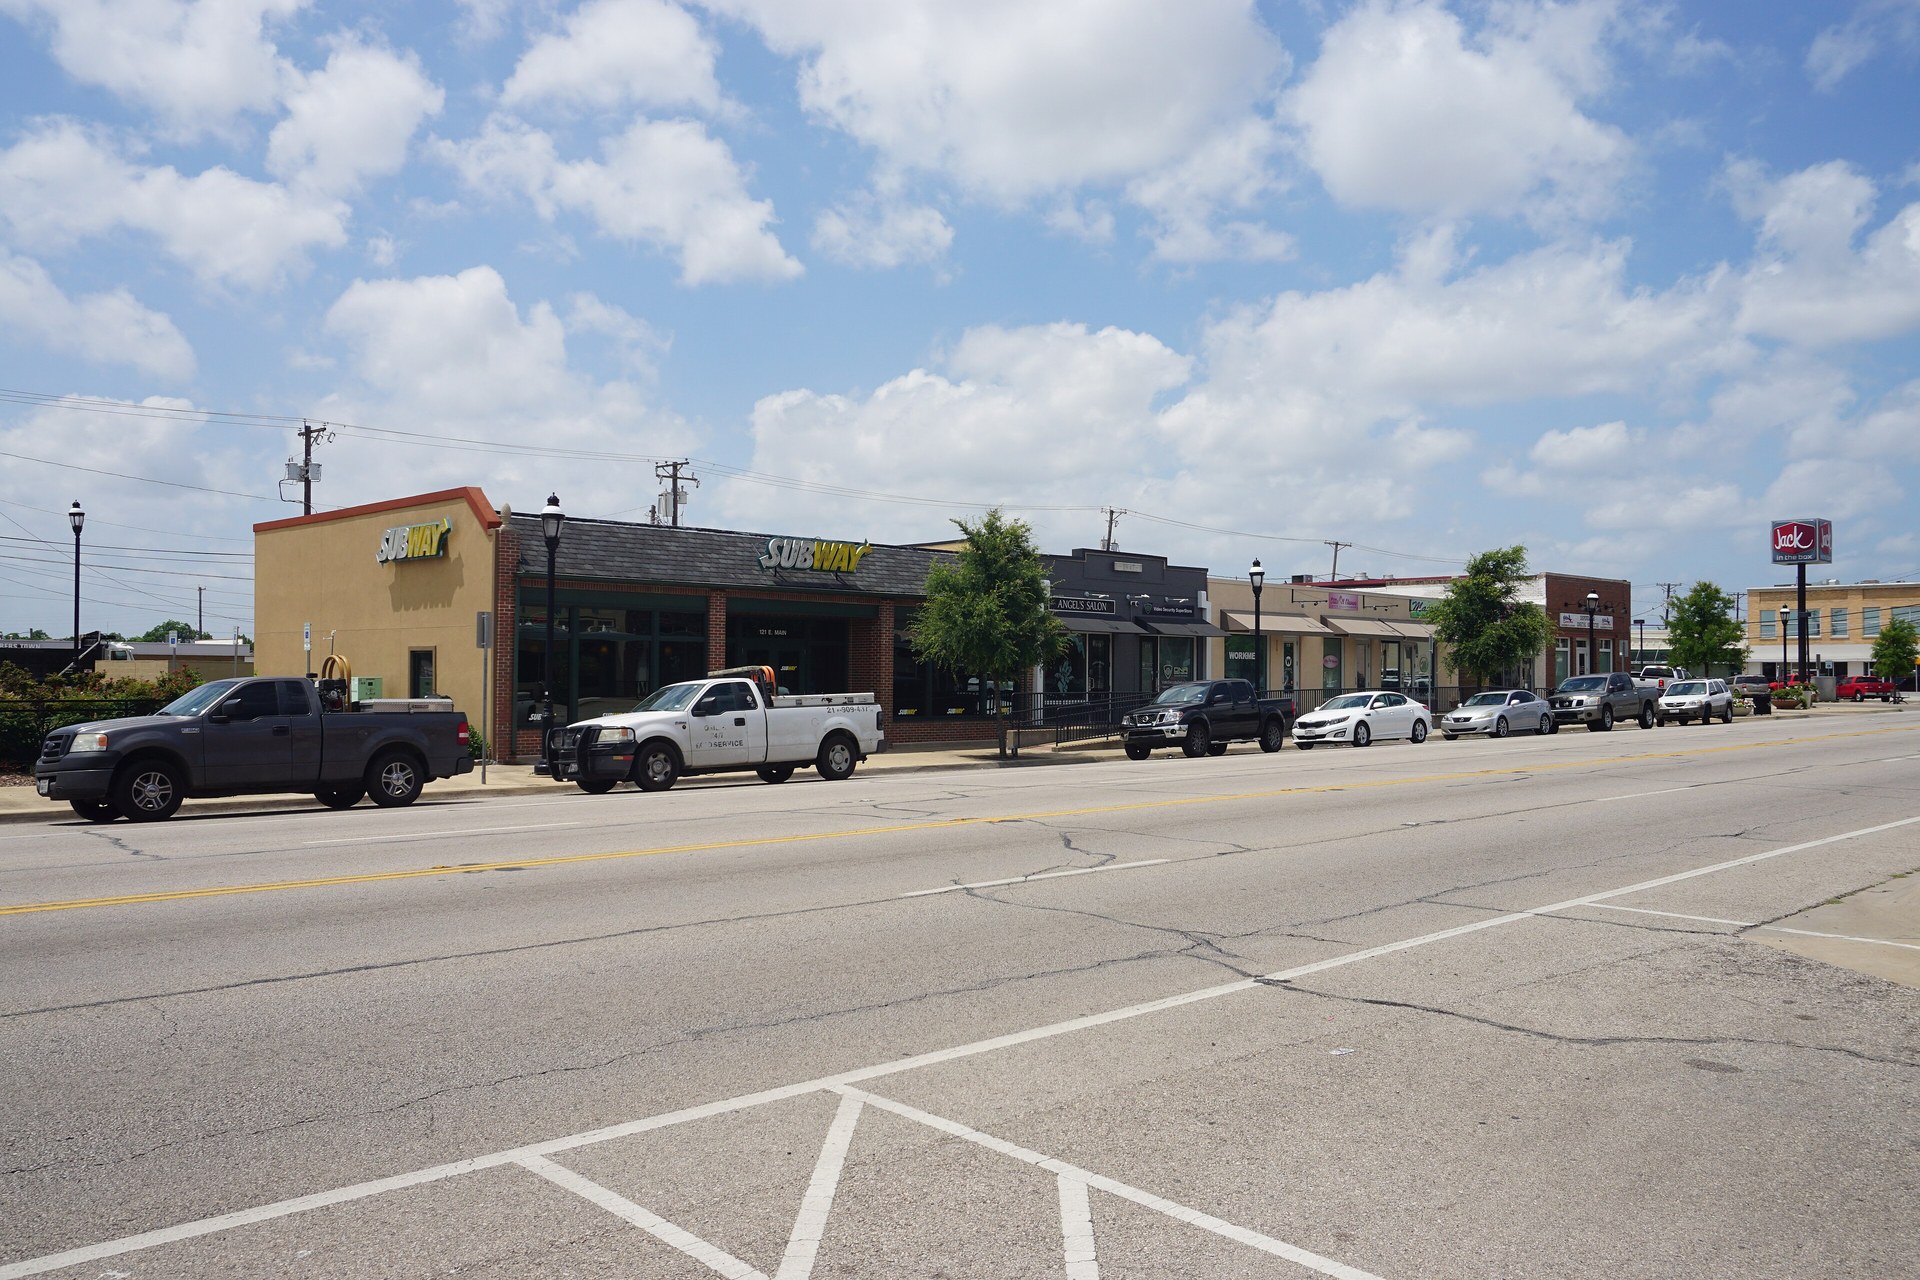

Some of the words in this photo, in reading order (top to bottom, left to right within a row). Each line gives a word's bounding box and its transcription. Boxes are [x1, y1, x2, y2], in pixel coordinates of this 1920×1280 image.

[376, 517, 448, 563] SUBWAY
[1774, 525, 1814, 550] Jack
[759, 538, 872, 573] SUBWAY
[1057, 599, 1085, 610] ANGEL'S
[1086, 601, 1107, 611] SALON
[1228, 651, 1256, 660] WORKME
[713, 740, 744, 748] SERVICE
